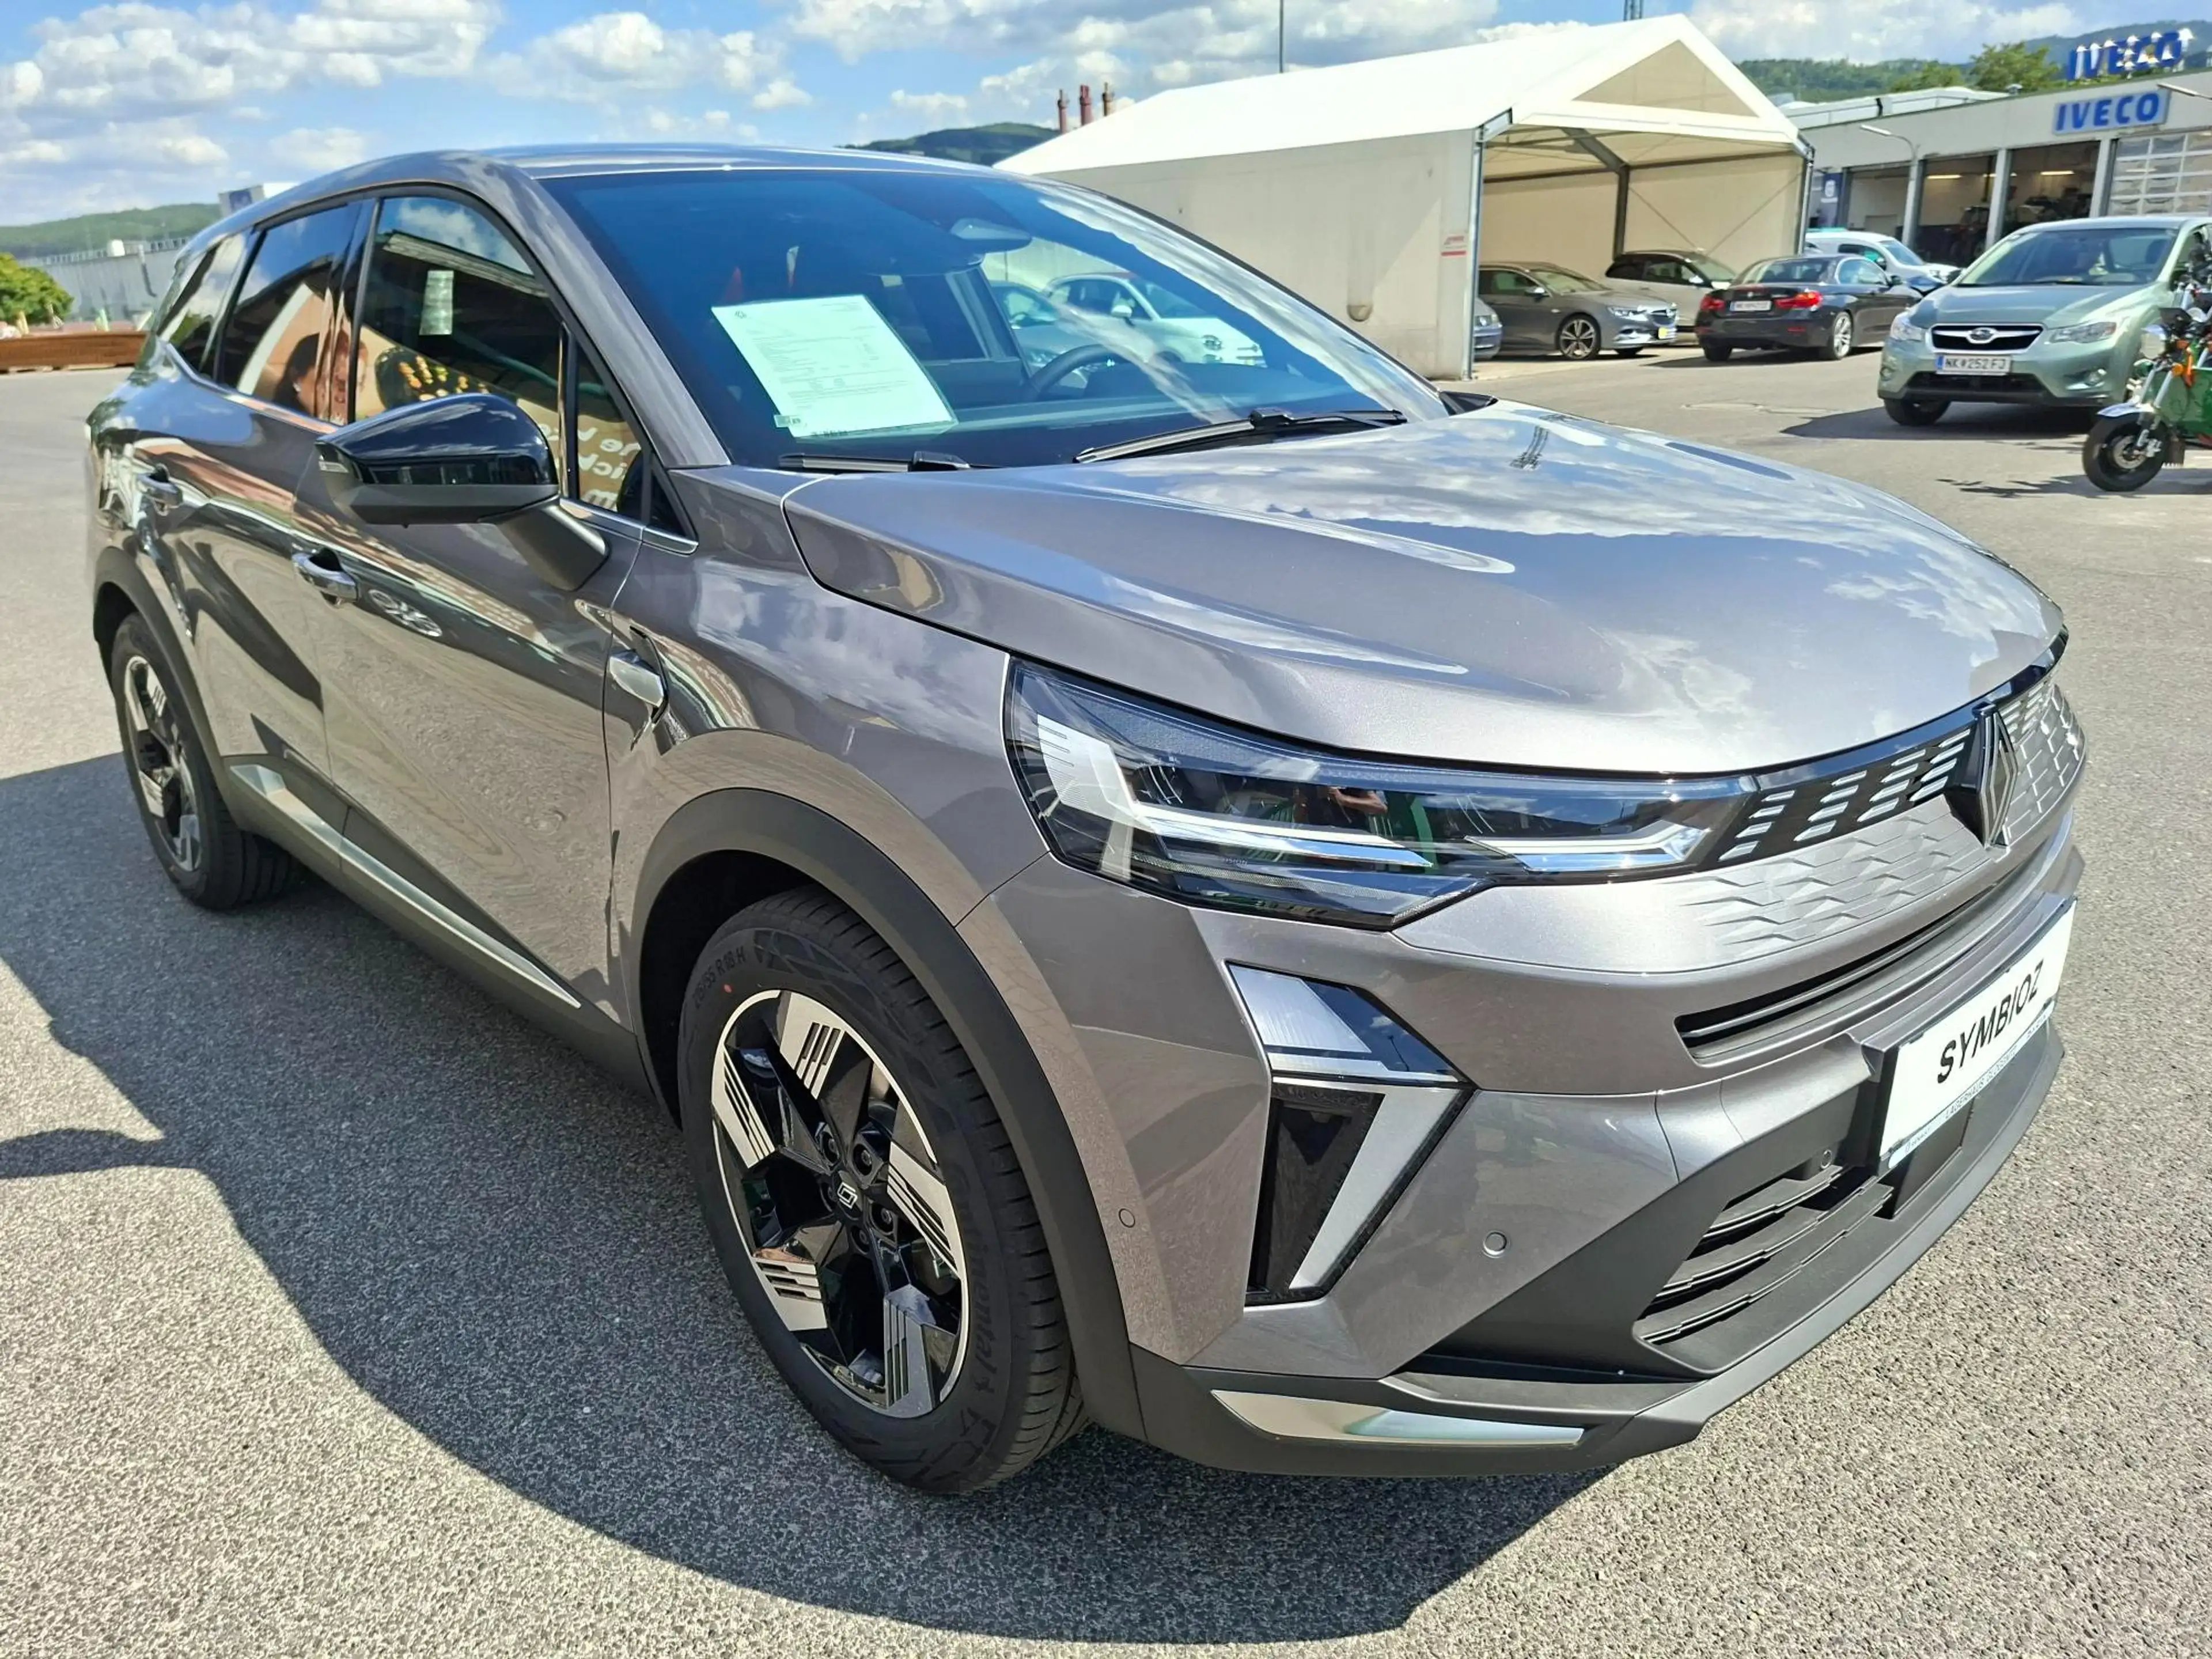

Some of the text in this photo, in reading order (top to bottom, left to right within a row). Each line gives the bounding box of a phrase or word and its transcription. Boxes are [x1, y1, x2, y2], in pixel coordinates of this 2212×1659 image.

[2067, 31, 2183, 82] IVECO
[2056, 93, 2159, 131] IVECO
[1937, 959, 2044, 1084] SYMBIOZ
